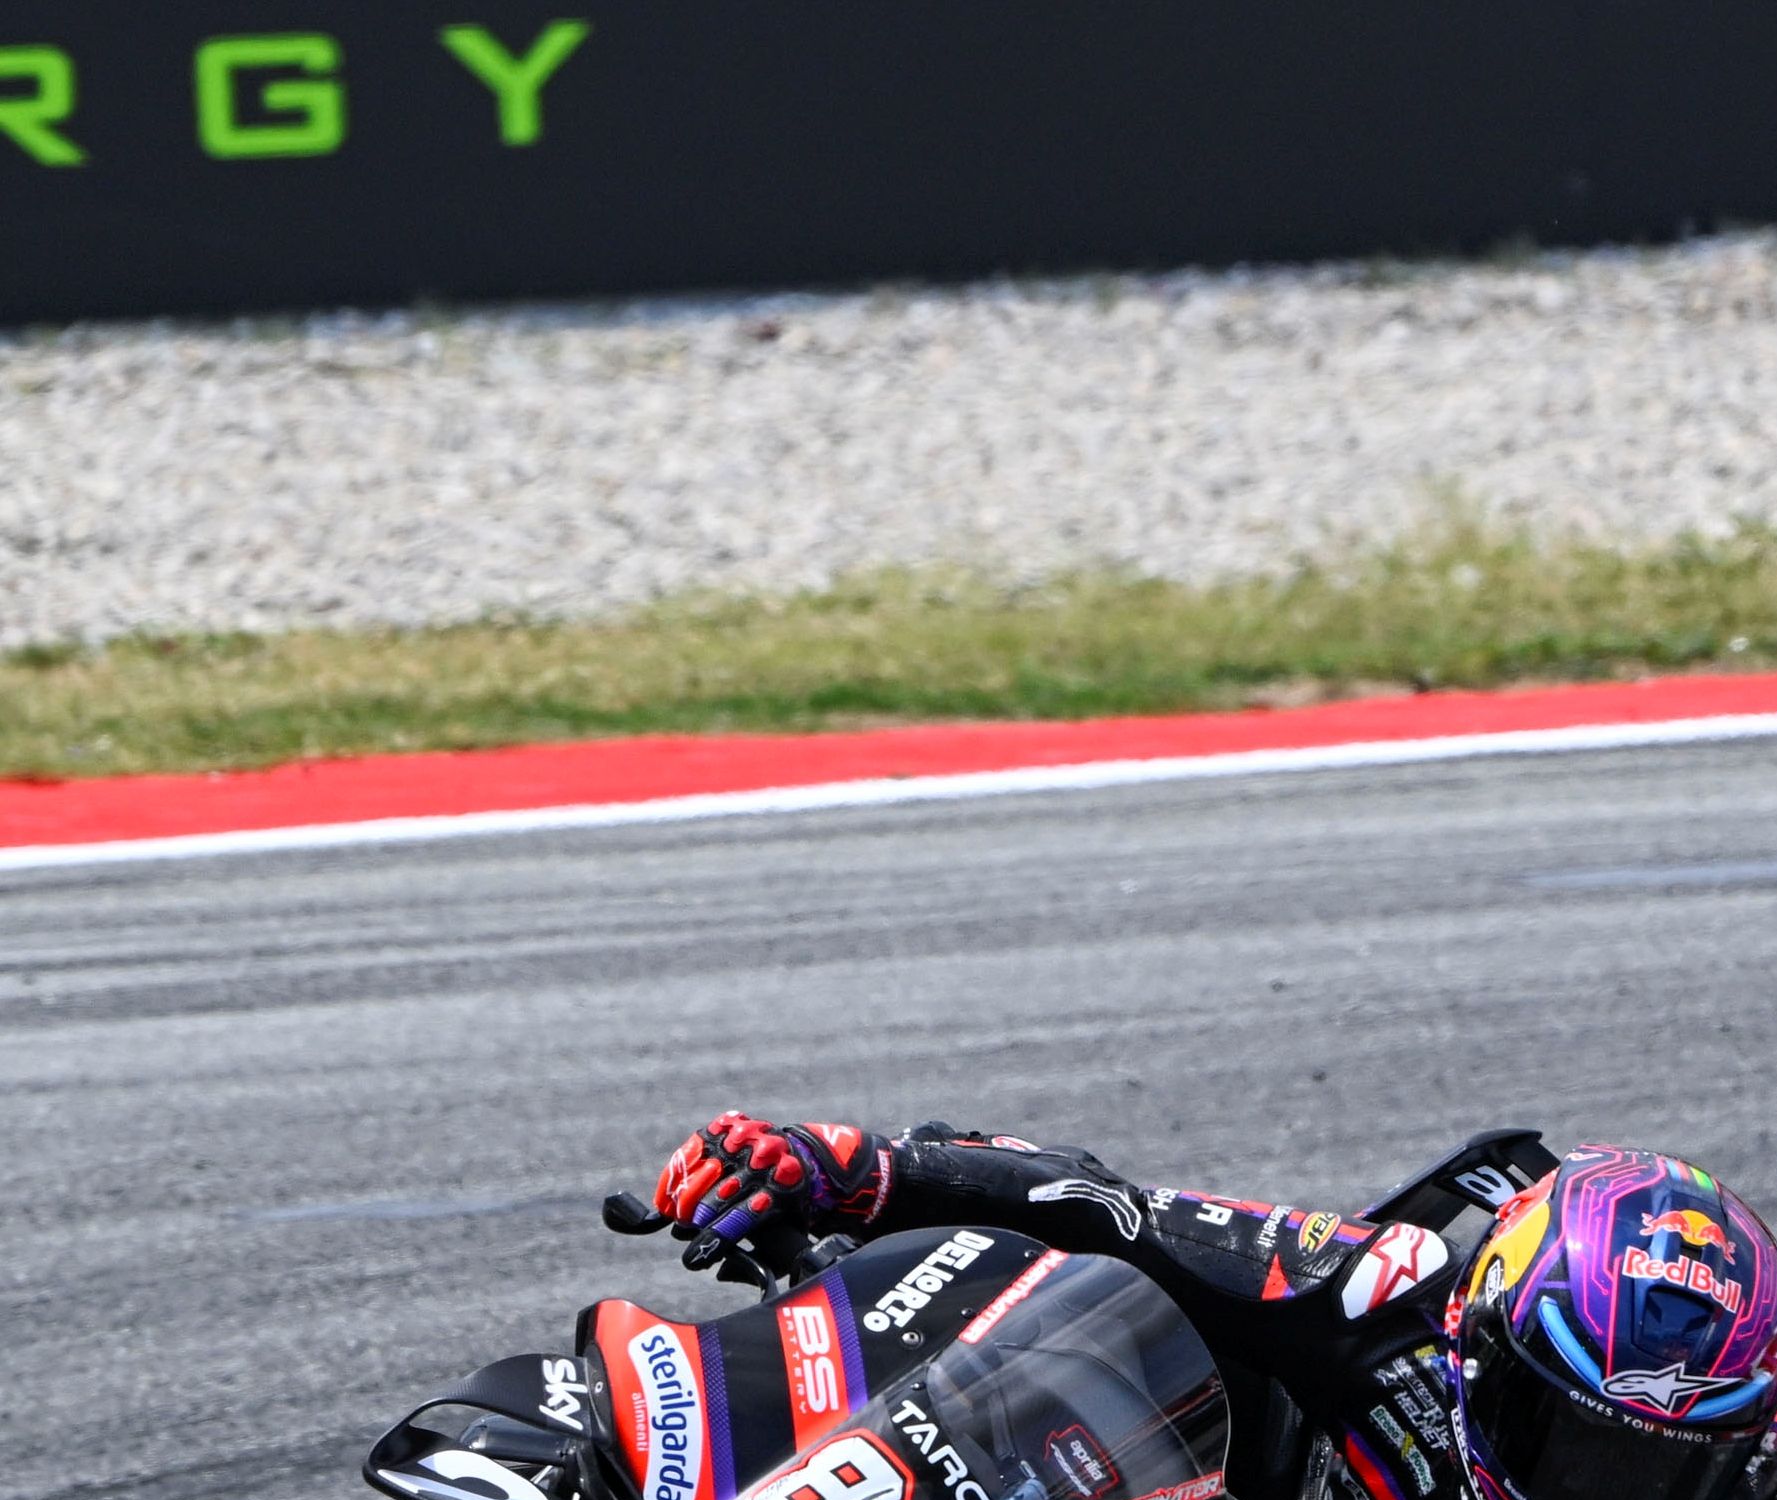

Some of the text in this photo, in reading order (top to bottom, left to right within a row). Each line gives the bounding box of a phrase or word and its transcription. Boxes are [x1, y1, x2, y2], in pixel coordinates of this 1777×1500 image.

[862, 1229, 995, 1333] DELLORTO
[1621, 1245, 1743, 1314] Red Bull
[792, 1305, 839, 1413] BS
[538, 1358, 589, 1431] sky
[631, 1391, 650, 1453] alimenti
[1394, 1390, 1450, 1453] HELMET
[1569, 1389, 1714, 1445] GIVES YOU WINGS
[1068, 1437, 1108, 1482] aprilia
